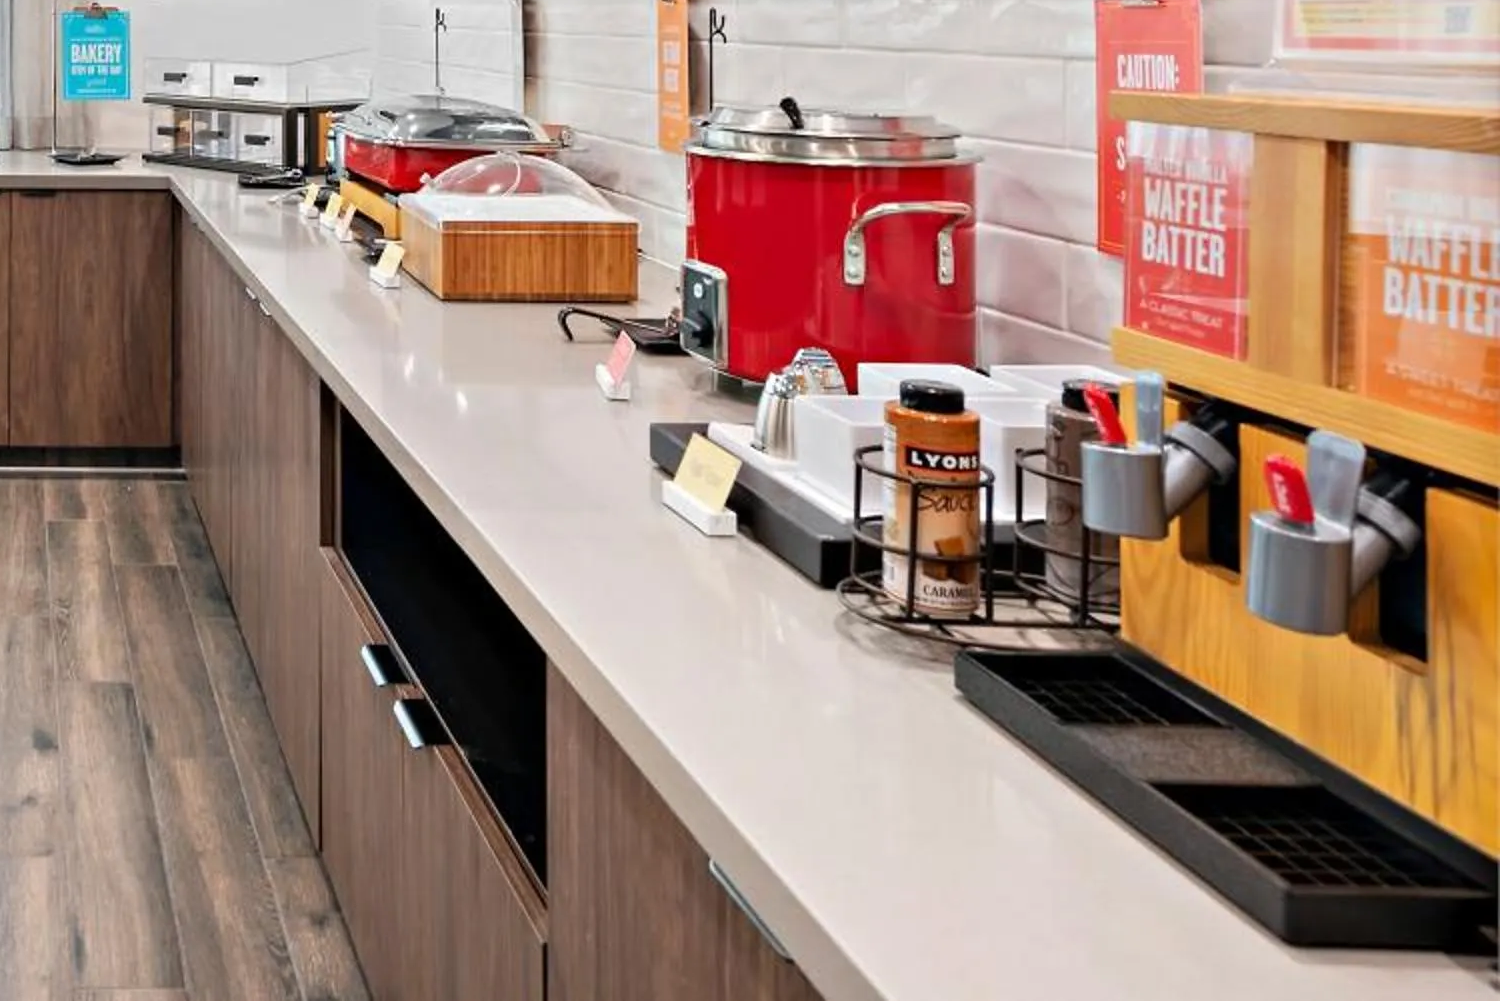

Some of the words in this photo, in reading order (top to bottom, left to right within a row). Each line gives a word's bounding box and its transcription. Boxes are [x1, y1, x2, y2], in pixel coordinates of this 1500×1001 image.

[71, 43, 122, 64] BAKERY
[1116, 54, 1180, 91] CAUTION:
[1143, 177, 1228, 232] WAFFLE
[1141, 221, 1225, 278] BATTER
[1383, 267, 1500, 340] BATTER
[911, 450, 977, 470] LYONS
